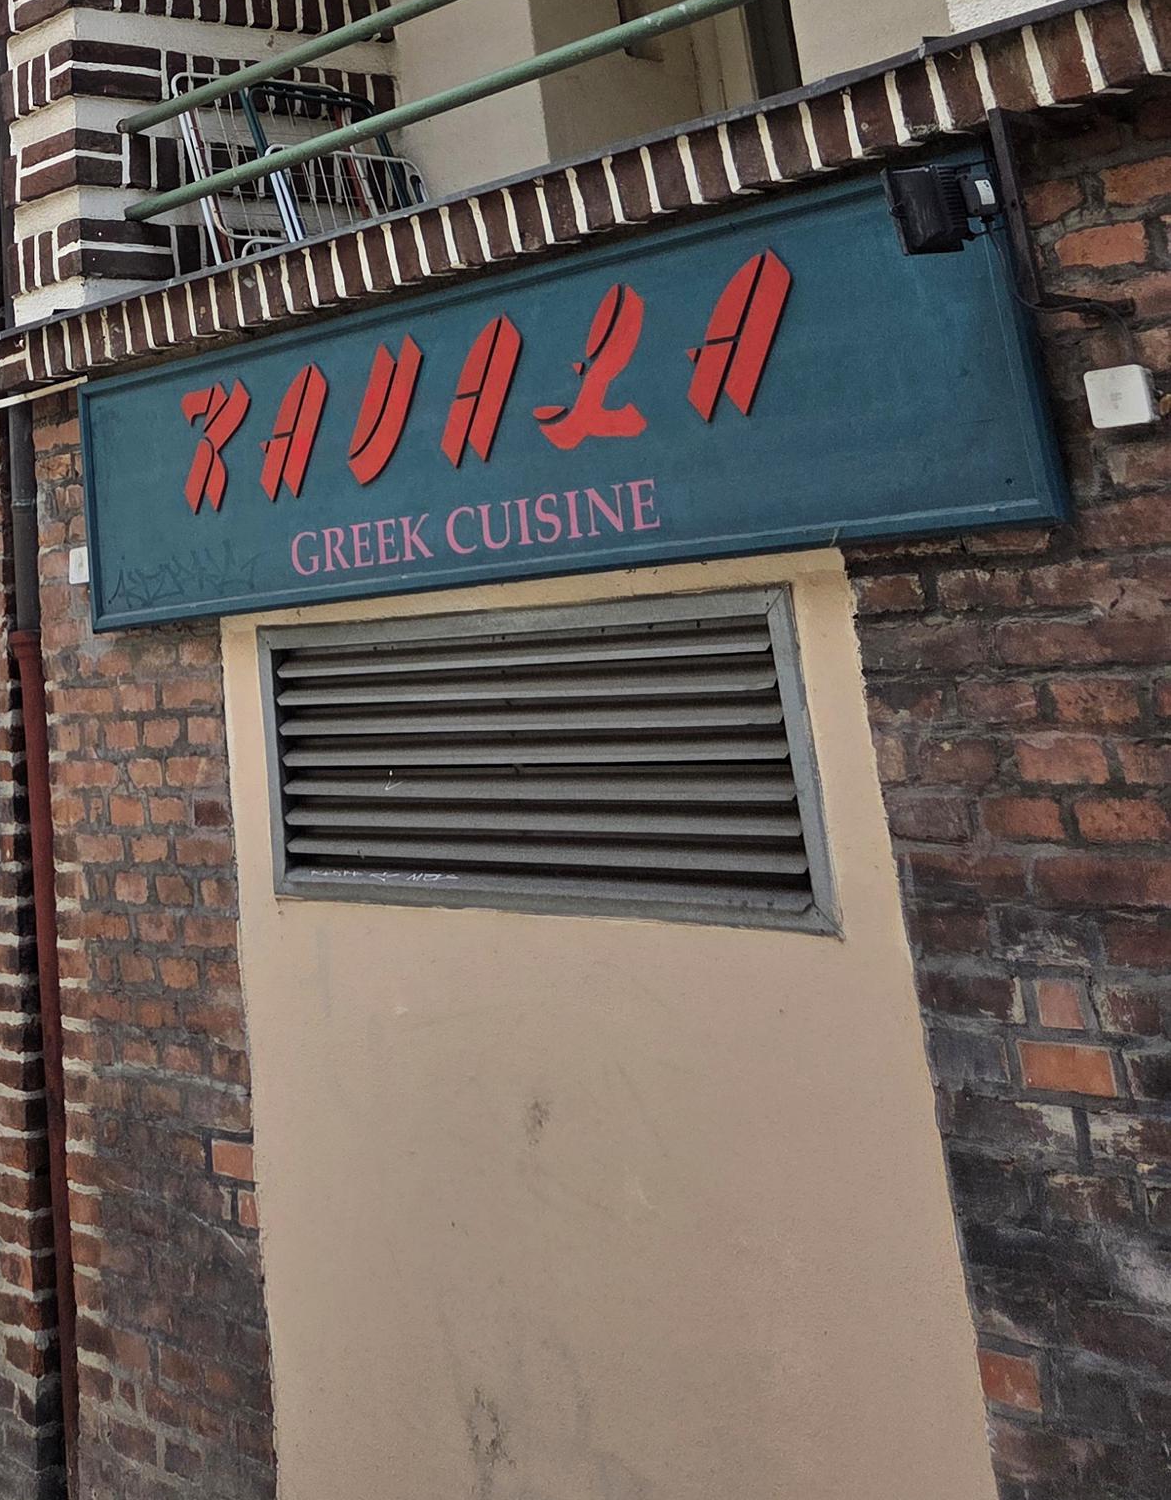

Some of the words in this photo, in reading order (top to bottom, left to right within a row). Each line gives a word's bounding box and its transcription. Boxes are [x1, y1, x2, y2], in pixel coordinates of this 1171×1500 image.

[180, 246, 792, 514] KAVALA
[290, 512, 435, 577] GREEK
[444, 477, 662, 555] CUISINE
